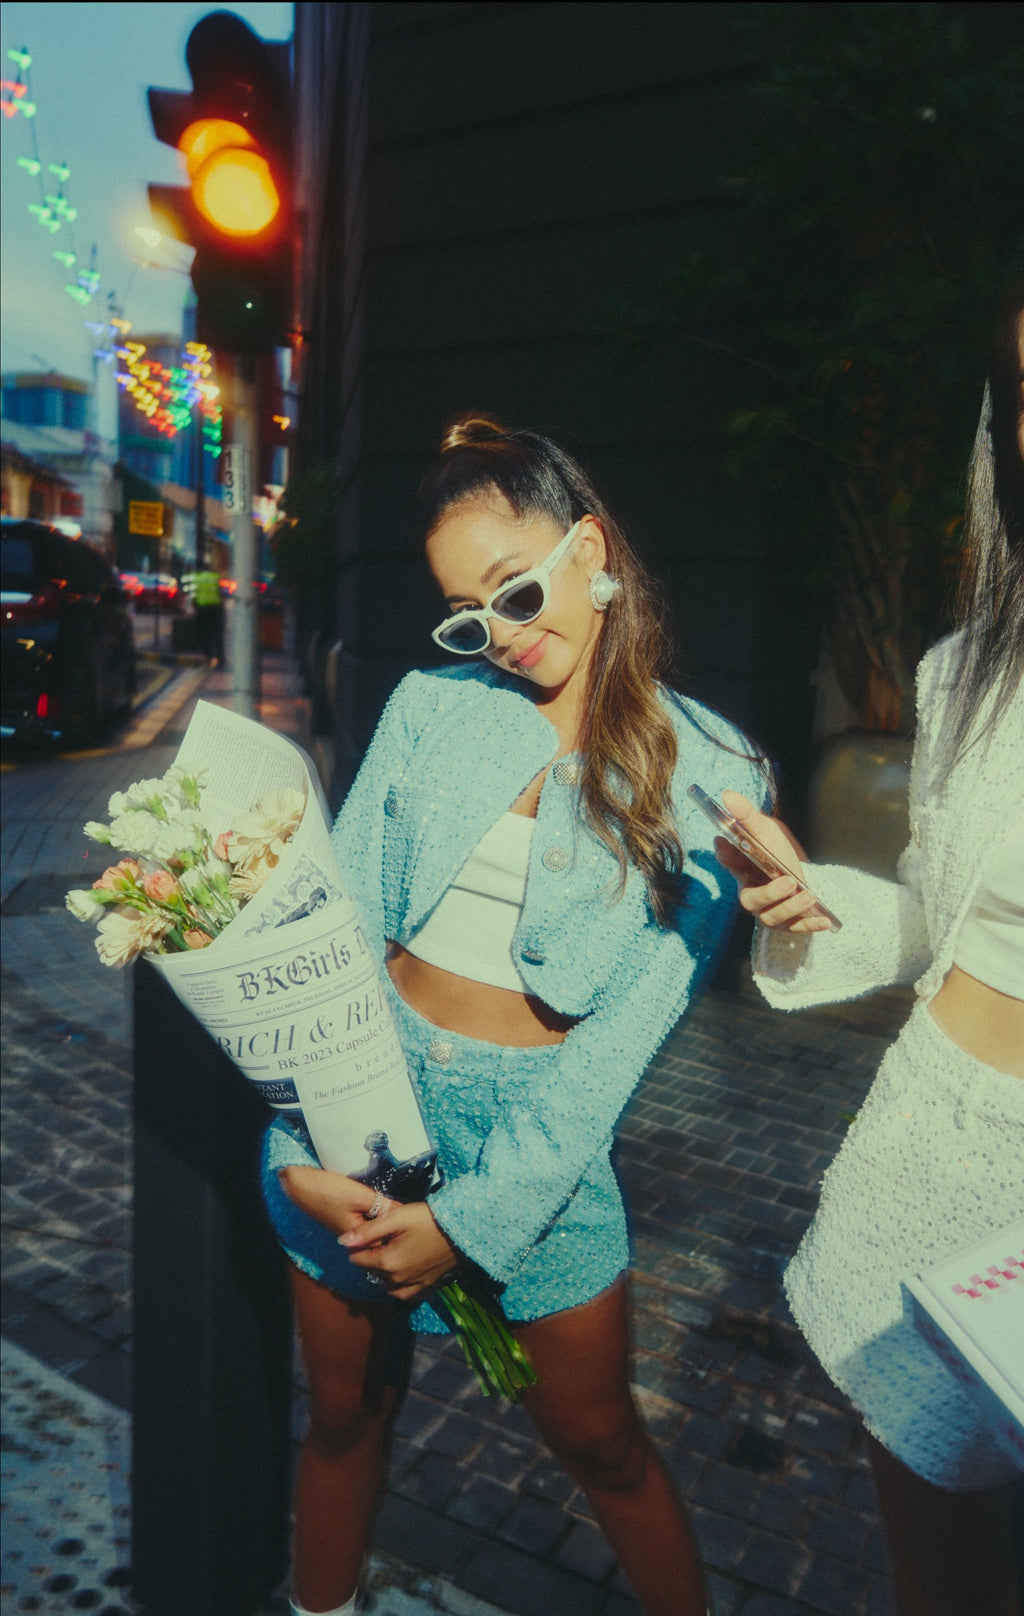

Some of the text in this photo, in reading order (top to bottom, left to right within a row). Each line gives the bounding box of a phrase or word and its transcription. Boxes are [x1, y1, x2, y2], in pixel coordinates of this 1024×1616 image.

[235, 937, 351, 1004] BKGirls
[217, 1024, 297, 1058] RICH
[309, 1014, 335, 1043] &
[278, 1056, 299, 1070] BK
[303, 1047, 333, 1065] 2023
[336, 1028, 378, 1054] Capsule
[314, 1090, 330, 1100] The
[331, 1079, 365, 1096] Fashion
